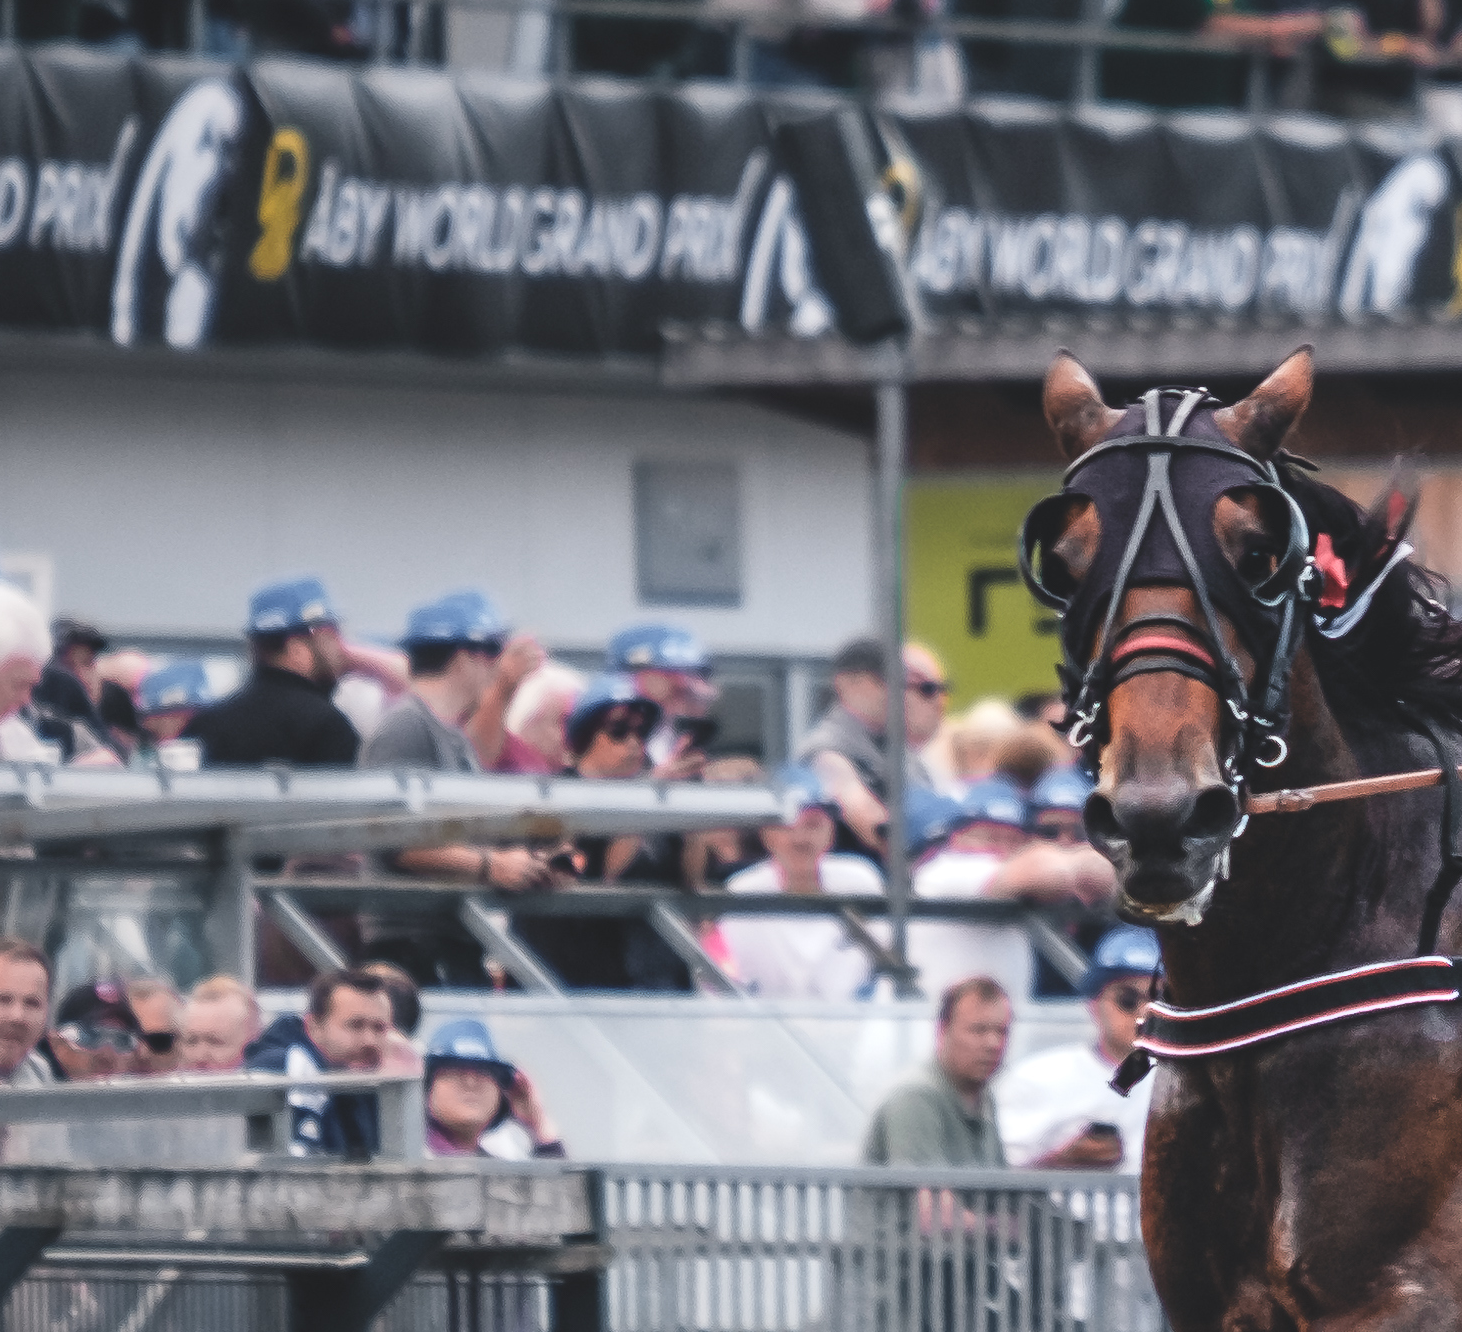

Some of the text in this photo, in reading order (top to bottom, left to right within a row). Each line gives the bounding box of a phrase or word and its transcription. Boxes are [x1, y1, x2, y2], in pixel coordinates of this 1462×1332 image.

[28, 116, 140, 254] PRIX
[392, 180, 524, 274] WORLD
[521, 183, 662, 281] GRAND
